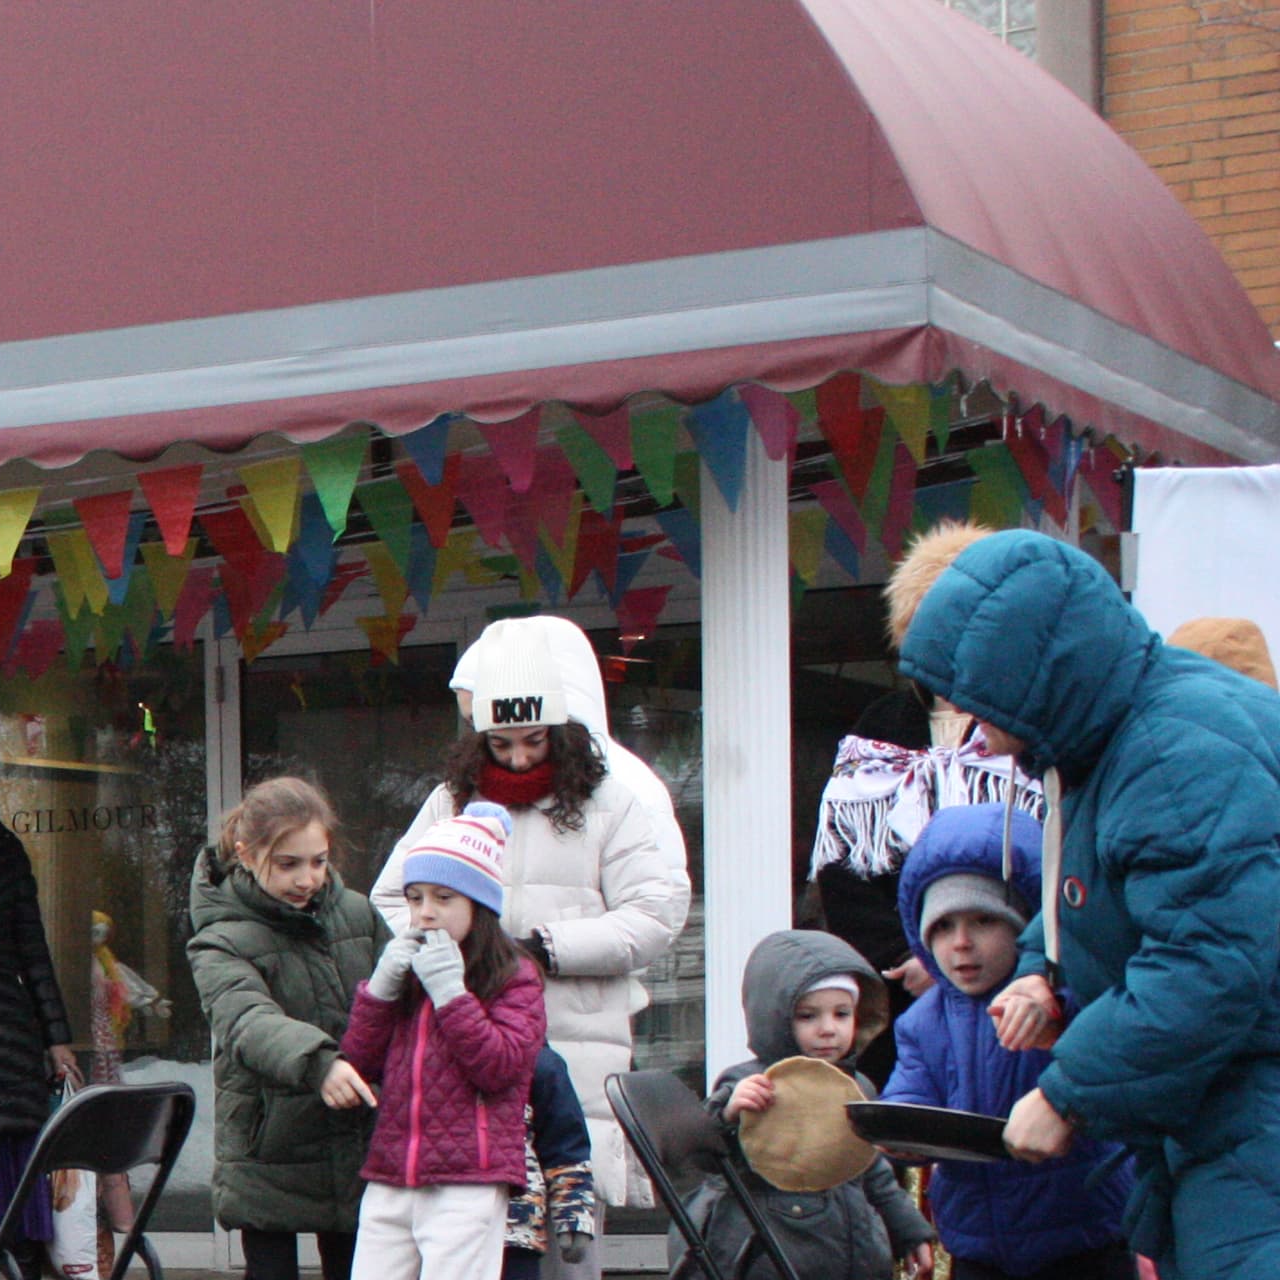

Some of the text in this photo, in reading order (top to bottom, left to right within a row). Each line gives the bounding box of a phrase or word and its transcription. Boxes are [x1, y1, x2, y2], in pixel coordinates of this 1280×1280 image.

[491, 696, 543, 724] DKNY
[11, 803, 158, 835] GILMOUR
[460, 834, 492, 858] RUN
